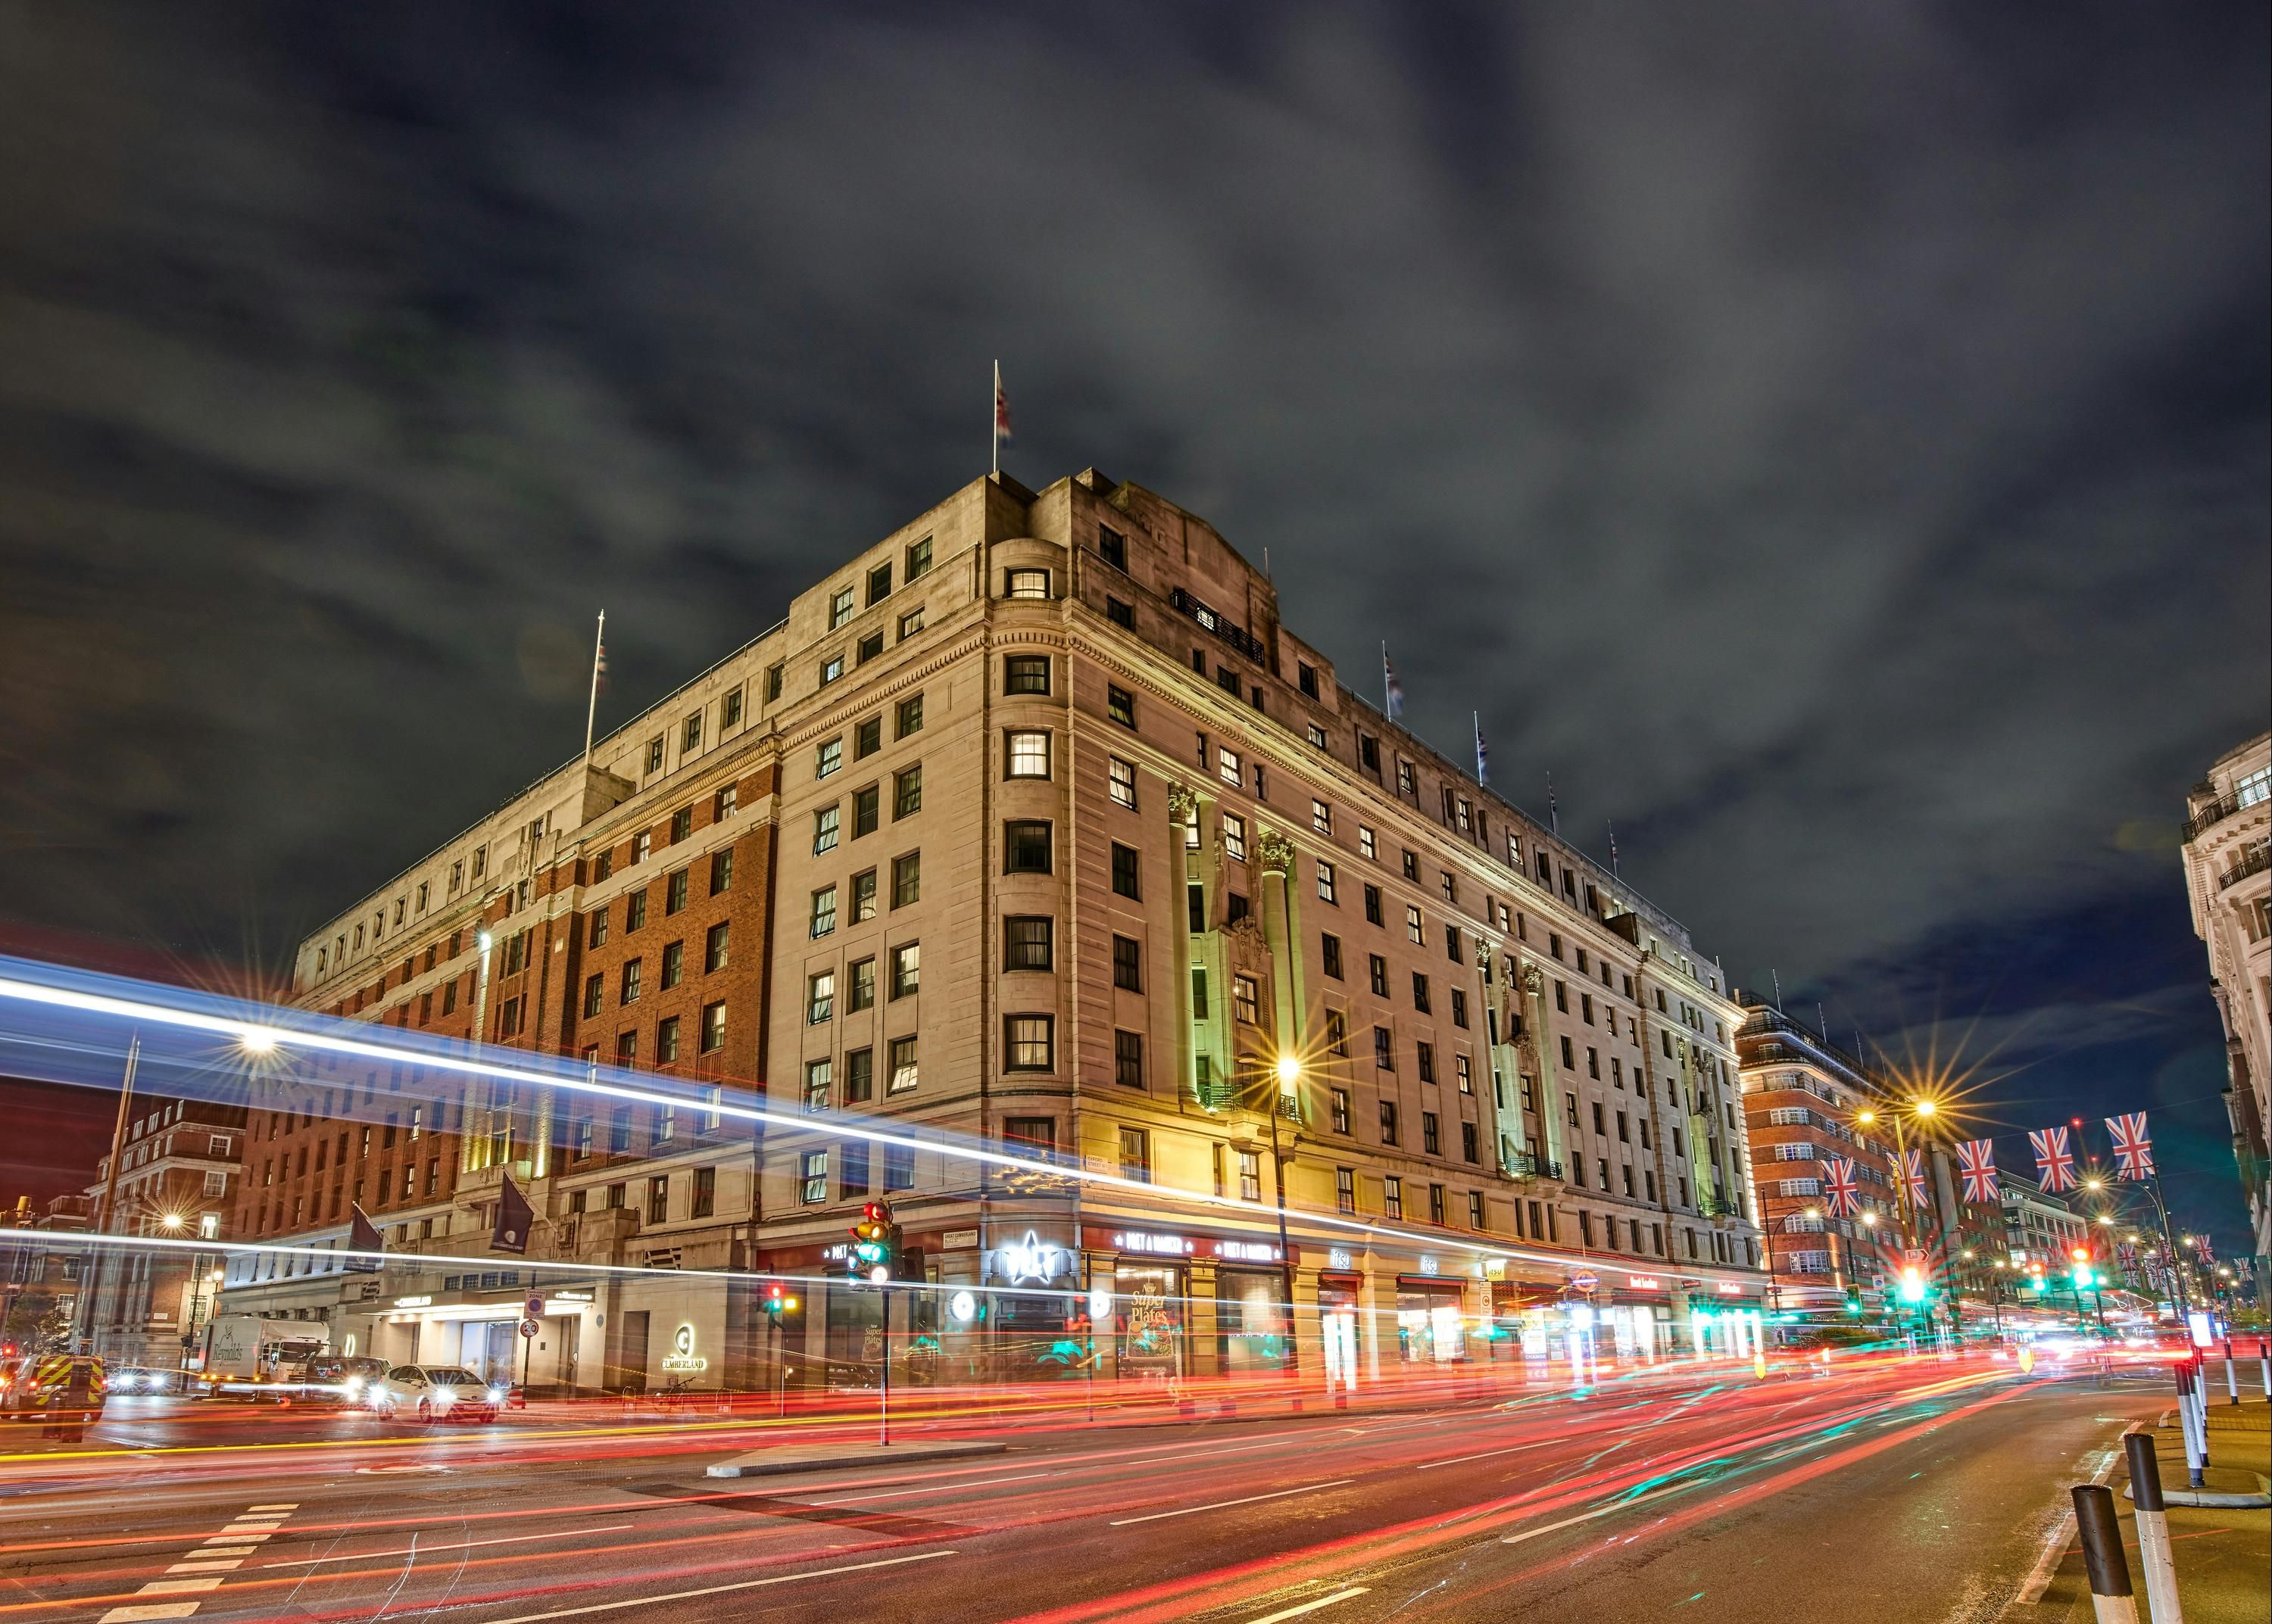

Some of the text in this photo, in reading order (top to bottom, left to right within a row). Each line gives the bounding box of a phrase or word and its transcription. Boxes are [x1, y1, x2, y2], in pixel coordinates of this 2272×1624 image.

[1333, 1250, 1351, 1267] itsu
[1422, 1257, 1438, 1273] itsu
[1142, 1283, 1156, 1292] New
[1131, 1290, 1166, 1311] Super
[1131, 1308, 1167, 1323] Plates
[524, 1324, 537, 1333] 20
[865, 1328, 882, 1337] Super
[865, 1336, 882, 1345] Plates
[213, 1343, 242, 1367] Reynolds
[661, 1360, 704, 1369] CUMBERLAND
